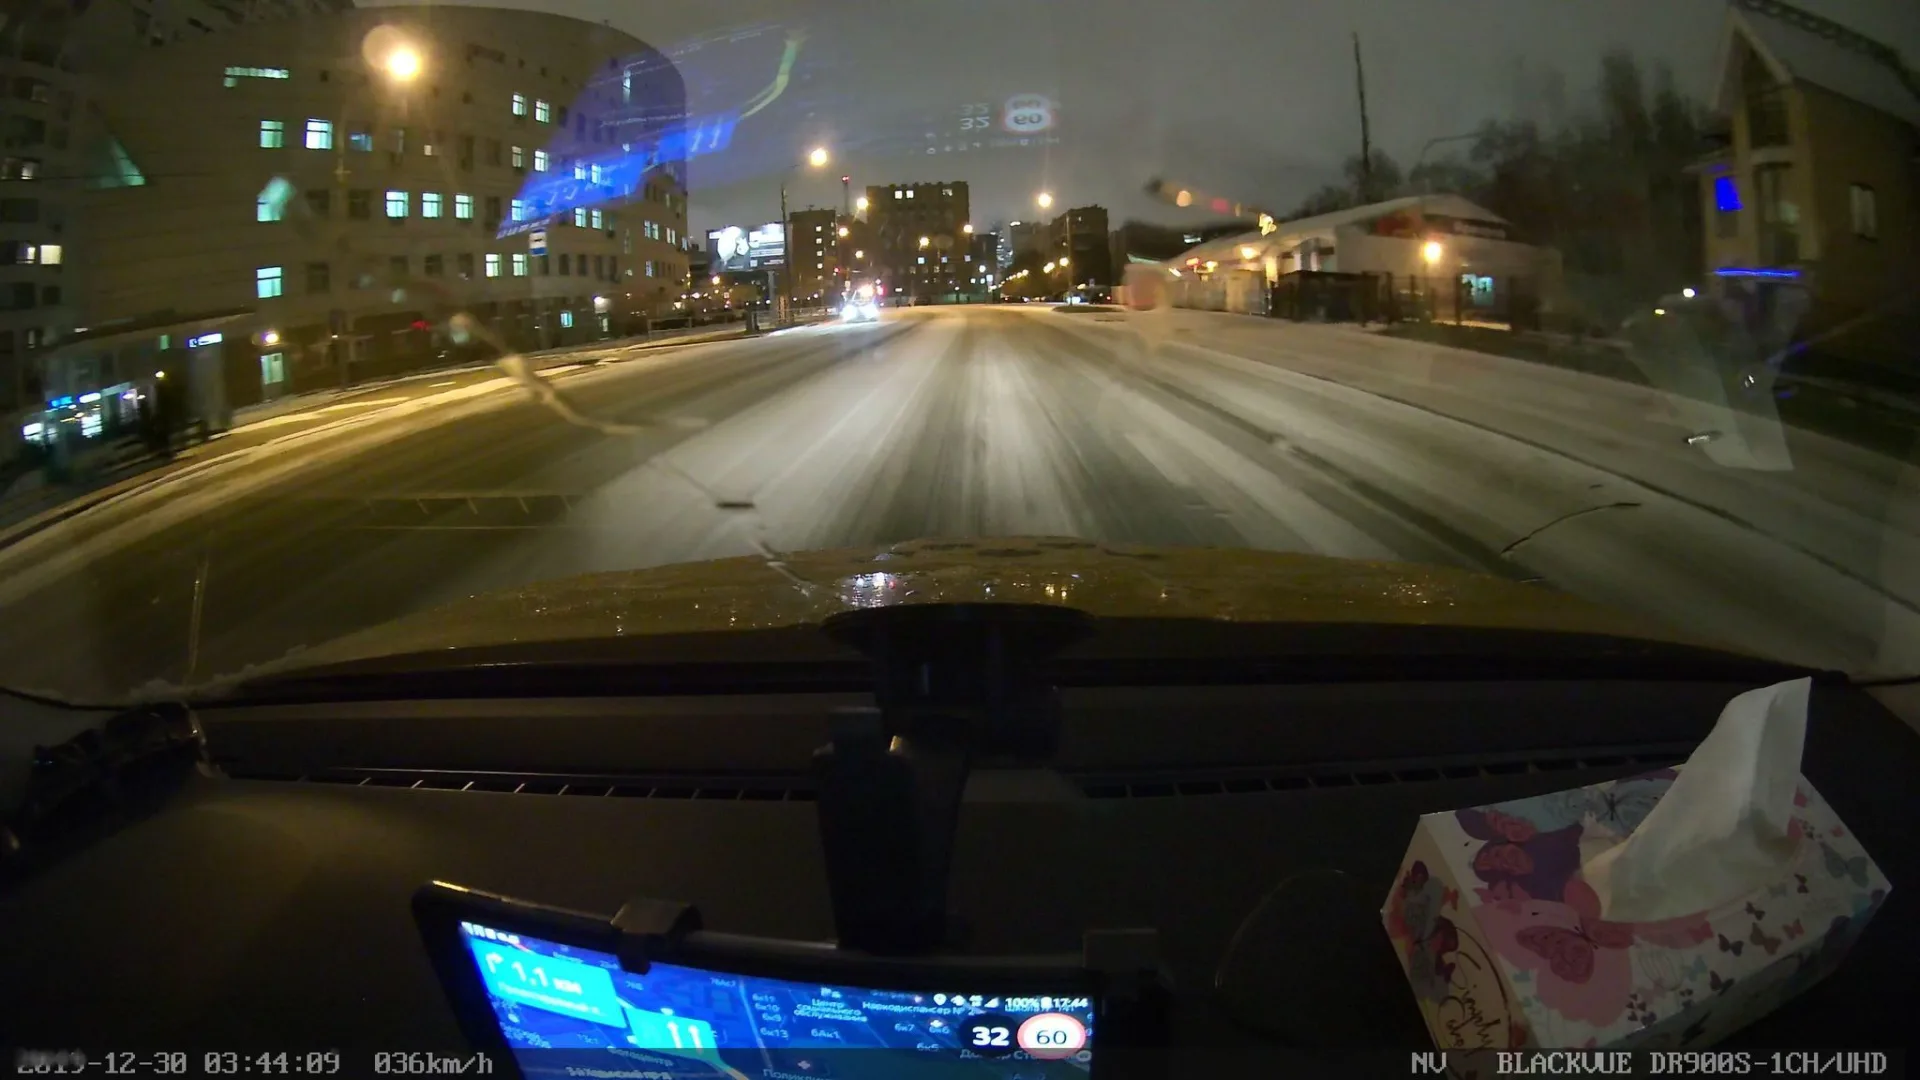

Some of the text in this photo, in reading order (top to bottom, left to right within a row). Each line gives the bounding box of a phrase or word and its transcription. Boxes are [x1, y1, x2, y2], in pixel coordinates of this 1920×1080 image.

[1005, 998, 1039, 1008] 100%
[1053, 997, 1088, 1008] 17:44
[972, 1026, 1010, 1047] 32
[1036, 1029, 1067, 1045] 60
